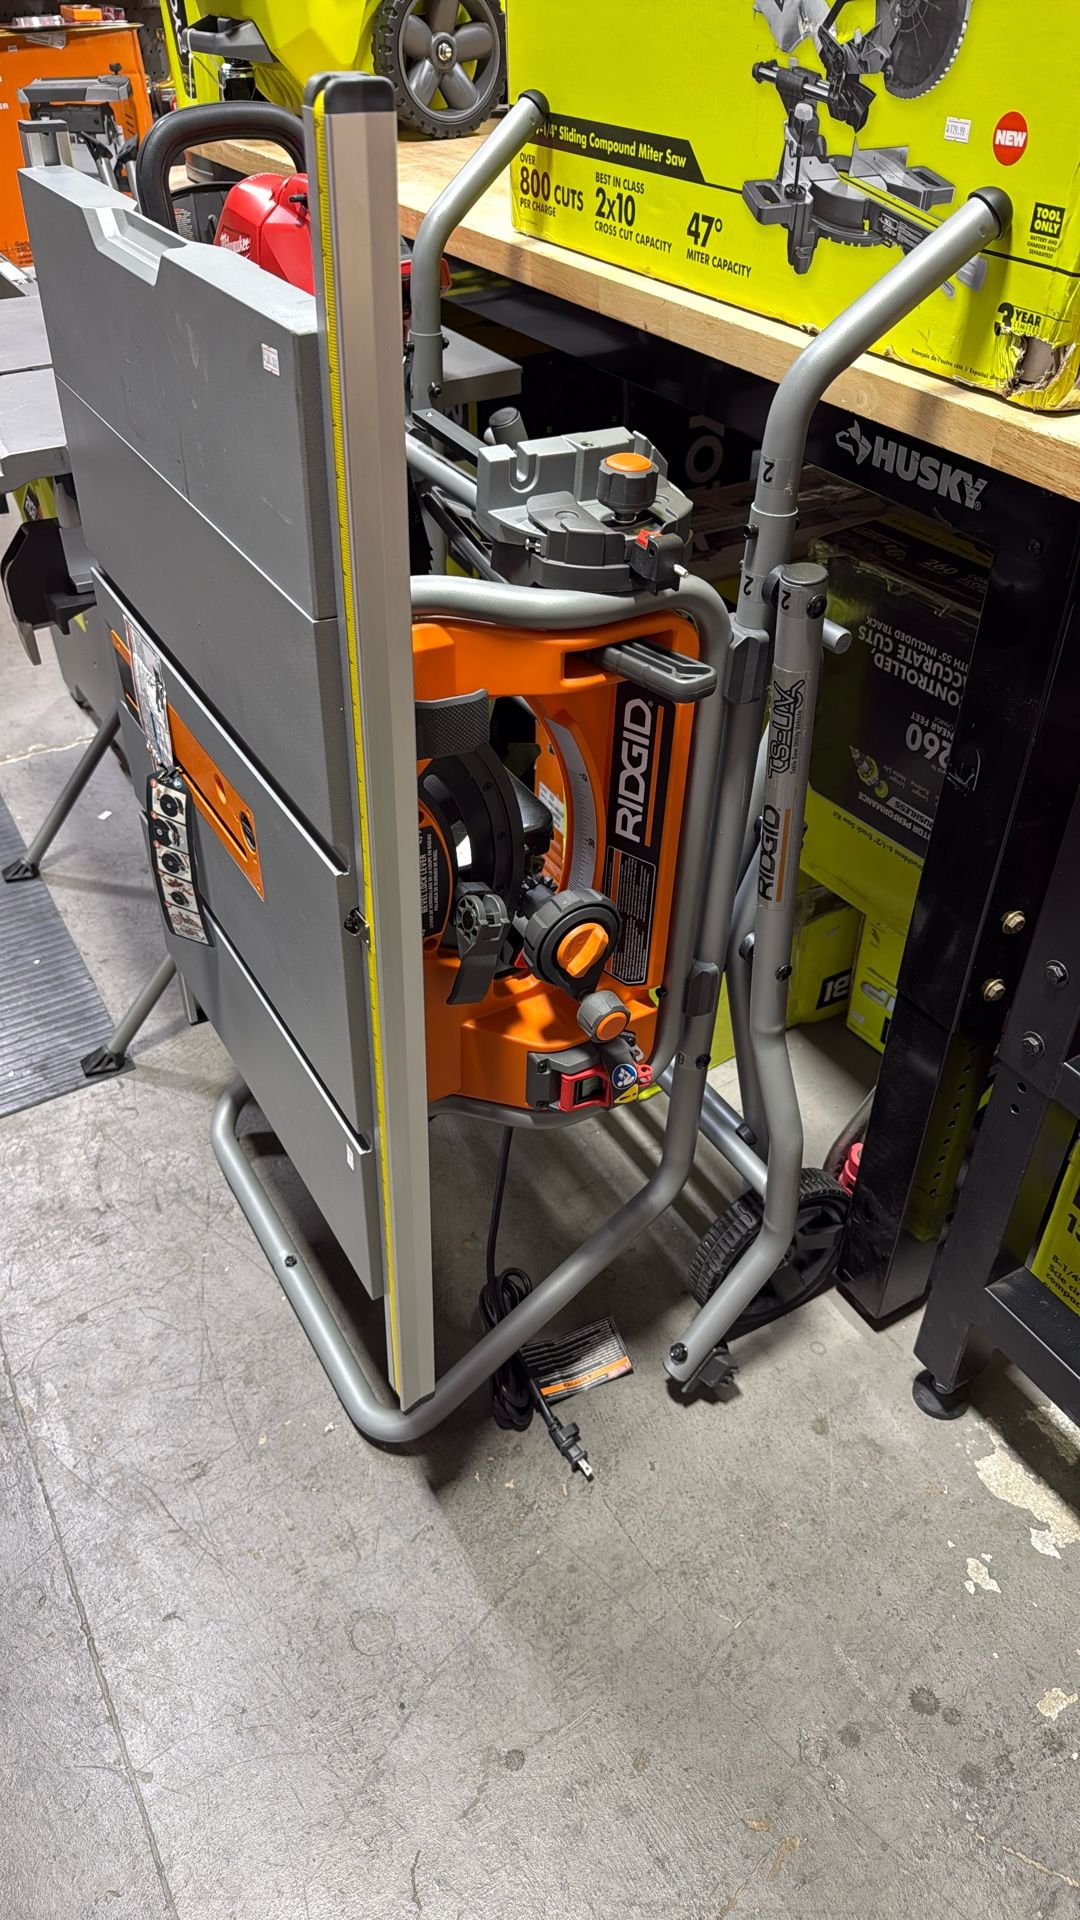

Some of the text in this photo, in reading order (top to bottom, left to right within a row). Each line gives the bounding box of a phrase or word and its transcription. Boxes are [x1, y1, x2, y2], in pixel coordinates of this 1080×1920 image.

[535, 123, 687, 168] -1/4" Sliding Compound Miter Saw
[995, 129, 1027, 148] NEW
[520, 153, 536, 166] OVER
[520, 167, 584, 212] 800 CUTS
[595, 172, 645, 195] BEST IN CLASS
[520, 197, 556, 217] PER CHARGE
[595, 187, 636, 227] 2x10
[1037, 206, 1061, 222] TOOL
[594, 221, 673, 254] CROSS CUT CAPACITY
[686, 212, 723, 248] 47°
[1034, 220, 1061, 235] ONLY
[1027, 240, 1046, 251] CHARGER
[1030, 235, 1058, 246] BATTERY AND
[686, 248, 752, 278] MITER CAPACITY
[1028, 248, 1053, 259] SEPARATELY
[994, 302, 1014, 336] 3
[1015, 309, 1042, 327] YEAR
[911, 348, 930, 361] Français
[930, 354, 938, 363] de
[872, 437, 989, 510] HUSKY
[866, 616, 893, 636] TRACK
[858, 625, 894, 654] CUTS
[894, 630, 938, 657] INCLUDED
[871, 647, 960, 706] ONTROLLED,
[953, 658, 969, 673] ITH
[910, 711, 954, 741] NEAR FEET
[793, 732, 801, 748] Utility
[905, 723, 952, 769] 260
[615, 698, 651, 843] RIDGID
[858, 791, 913, 830] PERFORMANCE
[758, 804, 780, 901] RIDGID
[894, 850, 924, 871] rushless
[1048, 1264, 1067, 1282] Scie
